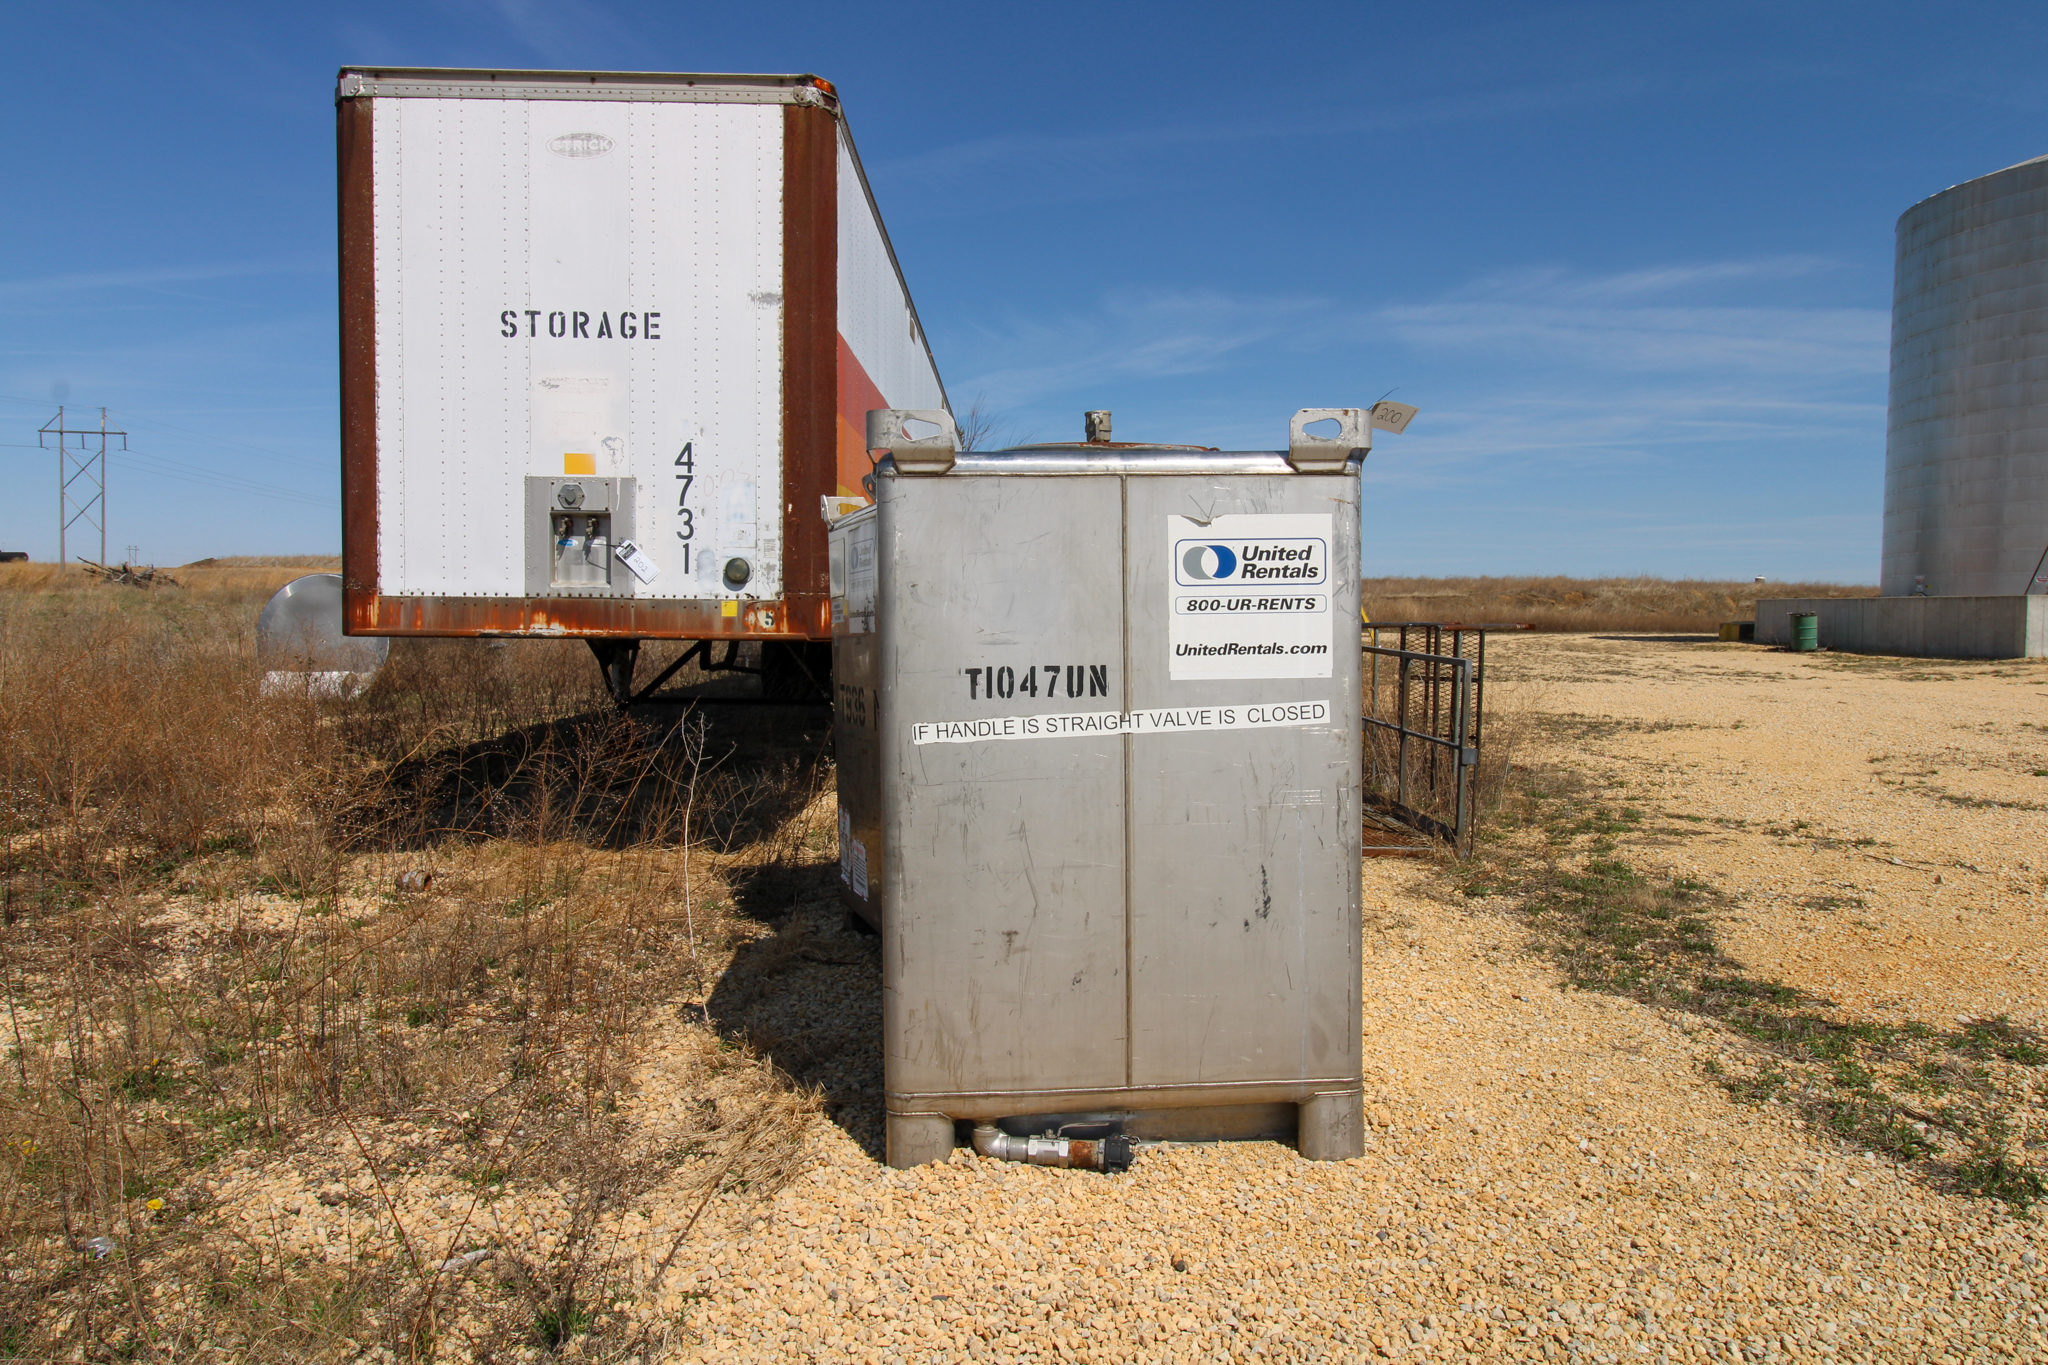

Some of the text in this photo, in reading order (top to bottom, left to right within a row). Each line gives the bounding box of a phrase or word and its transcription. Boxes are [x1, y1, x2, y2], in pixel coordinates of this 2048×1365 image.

[501, 310, 661, 340] STORAGE
[1377, 408, 1403, 424] 200
[674, 442, 695, 575] 4731
[1242, 545, 1313, 561] United
[633, 556, 649, 574] 202
[1241, 563, 1319, 579] Rentals
[1187, 598, 1316, 612] 800-UR-RENTS
[1175, 642, 1328, 657] UnitedRentals.com
[913, 703, 1326, 741] IF HANDLE IS STRAIGHT VALVE IS CLOSED
